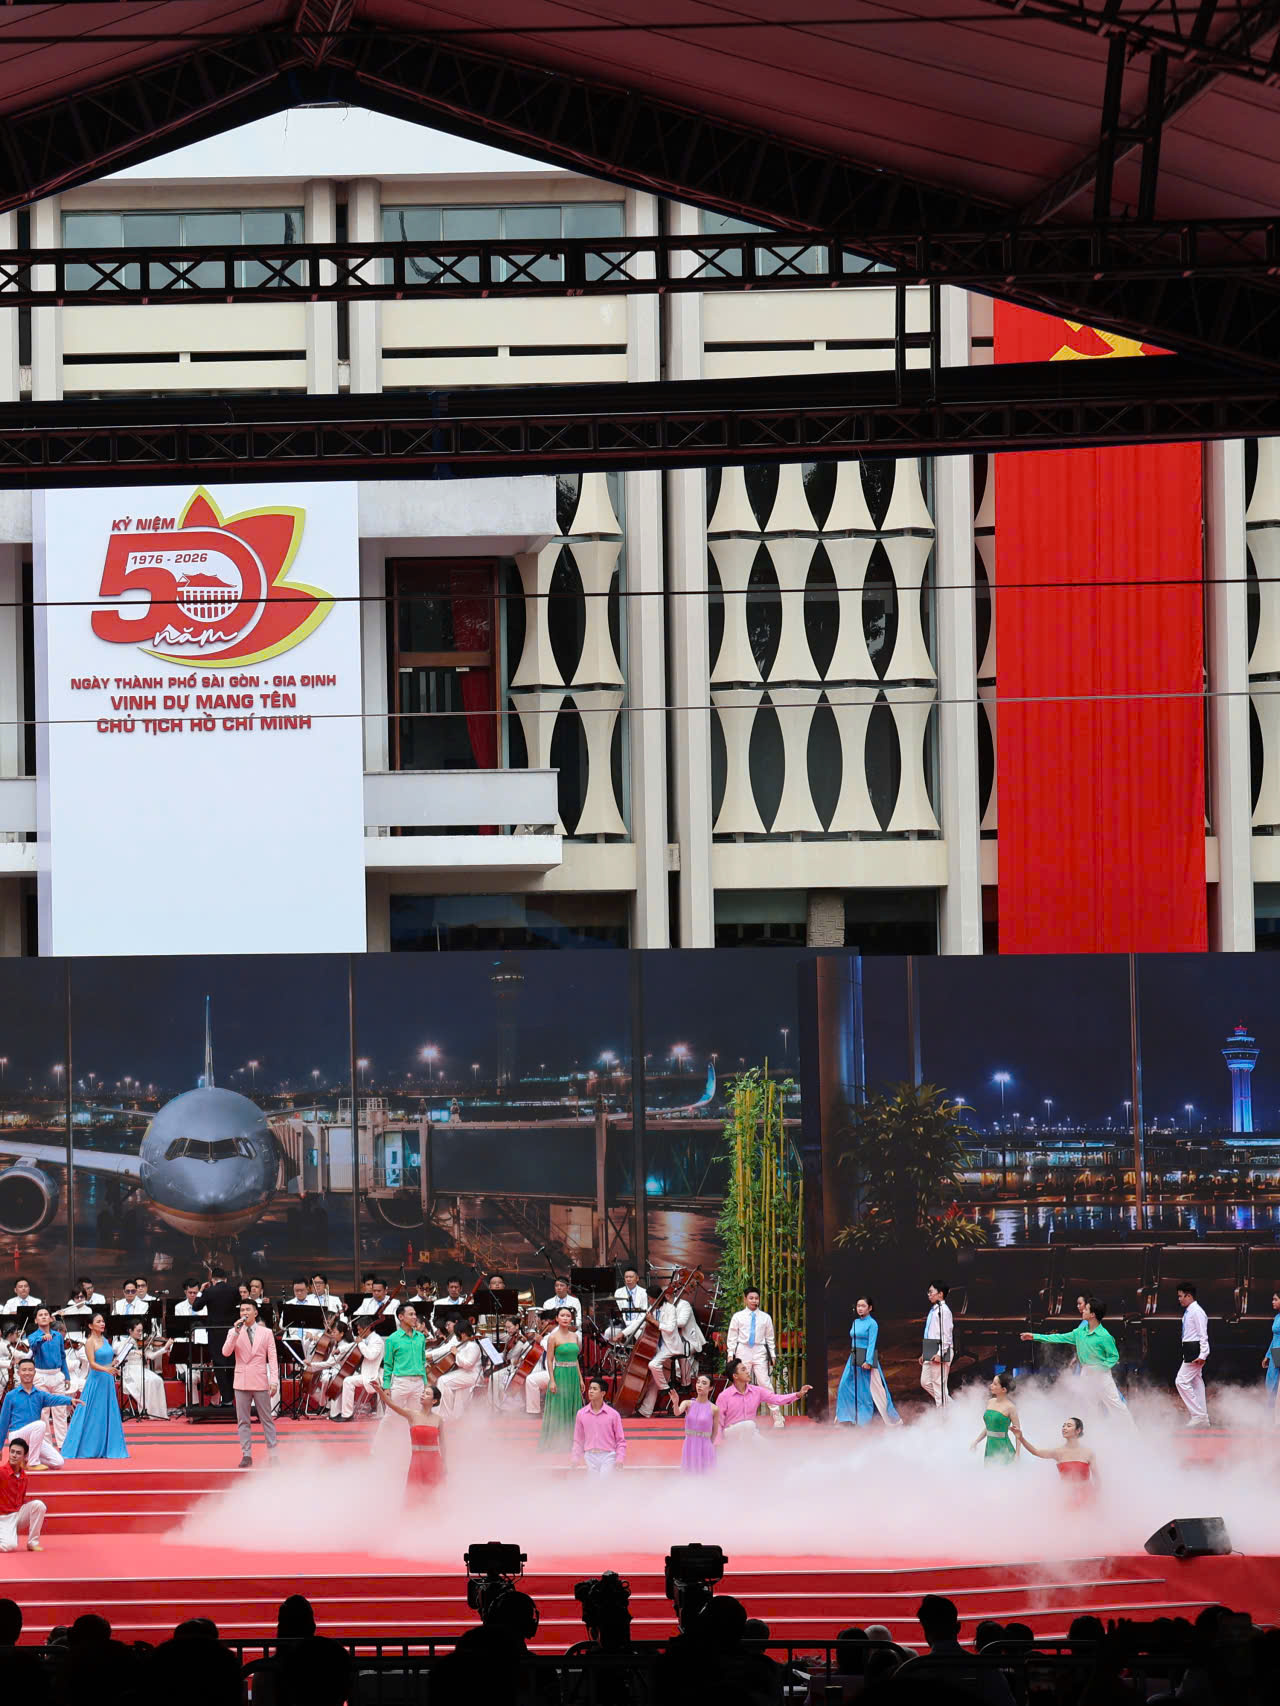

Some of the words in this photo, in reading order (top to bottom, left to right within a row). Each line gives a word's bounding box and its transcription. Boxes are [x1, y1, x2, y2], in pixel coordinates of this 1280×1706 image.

[111, 515, 132, 531] KỶ
[136, 516, 176, 532] NIỆM
[131, 554, 164, 565] 1976
[174, 553, 208, 563] 2026
[91, 531, 262, 644] 50
[153, 626, 238, 647] năm
[71, 675, 110, 690] NGÀY
[114, 674, 163, 689] THÀNH
[168, 672, 198, 688] PHỐ
[202, 674, 224, 688] SÀI
[229, 673, 260, 687] GÒN
[273, 675, 297, 687] GIA
[300, 674, 337, 689] ĐỊNH
[110, 695, 157, 711] VINH
[163, 694, 190, 713] DỰ
[196, 694, 254, 709] MANG
[260, 690, 296, 708] TÊN
[96, 713, 136, 733] CHỦ
[142, 718, 183, 736] TỊCH
[190, 711, 216, 732] HỒ
[222, 712, 255, 731] CHÍ
[260, 715, 312, 731] MINH
